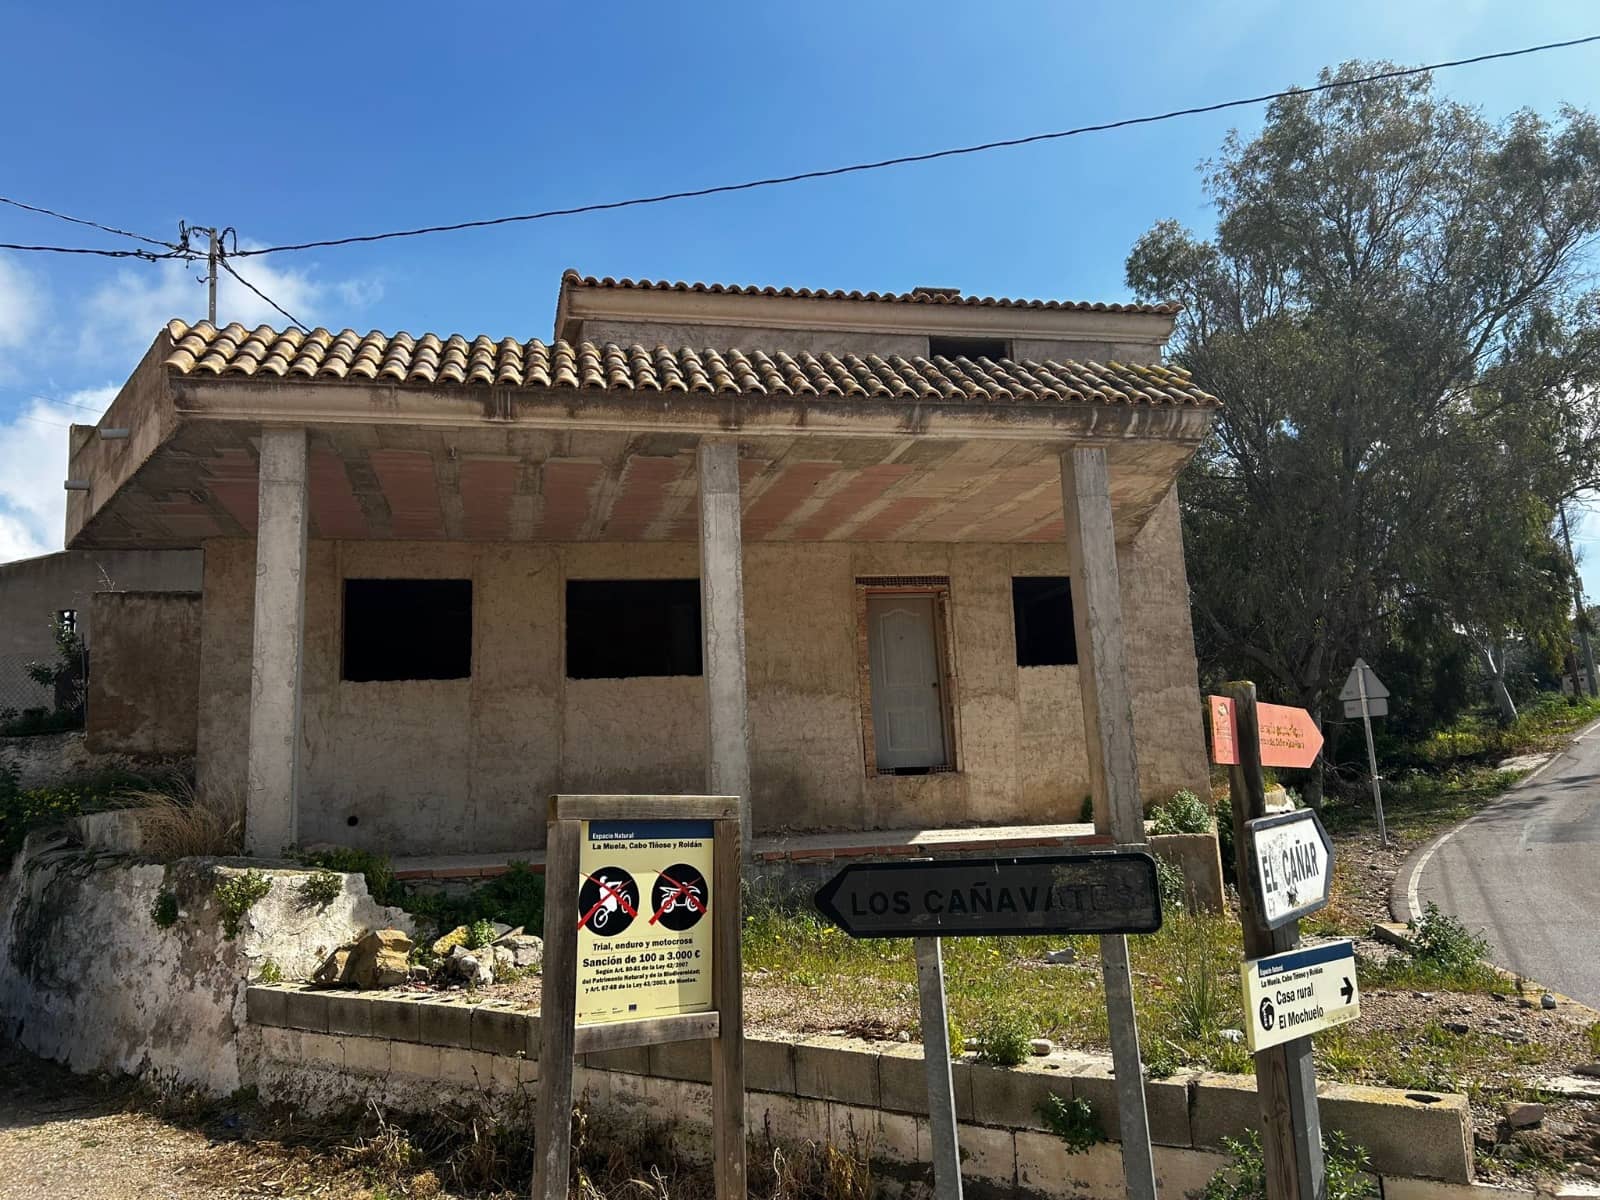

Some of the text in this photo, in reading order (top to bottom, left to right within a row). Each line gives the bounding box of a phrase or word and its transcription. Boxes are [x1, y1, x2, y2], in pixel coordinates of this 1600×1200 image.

[592, 831, 634, 841] Espacio Natural
[592, 840, 702, 850] La Muela, Cabo Tiñoso y Roldán
[1262, 840, 1319, 893] EL CAÑAR
[851, 891, 912, 916] LOS
[593, 937, 693, 951] Trial, enduro y motocross
[582, 955, 622, 968] Sanción
[624, 954, 637, 964] de
[639, 952, 657, 963] 100
[667, 950, 693, 960] 3.000
[694, 949, 701, 958] €
[595, 967, 613, 976] Según
[655, 963, 665, 971] Ley
[624, 973, 645, 981] Natural
[632, 980, 642, 989] Ley
[1260, 980, 1267, 988] La
[1276, 982, 1314, 1005] Casa rural
[1278, 1005, 1324, 1030] El Mochuelo
